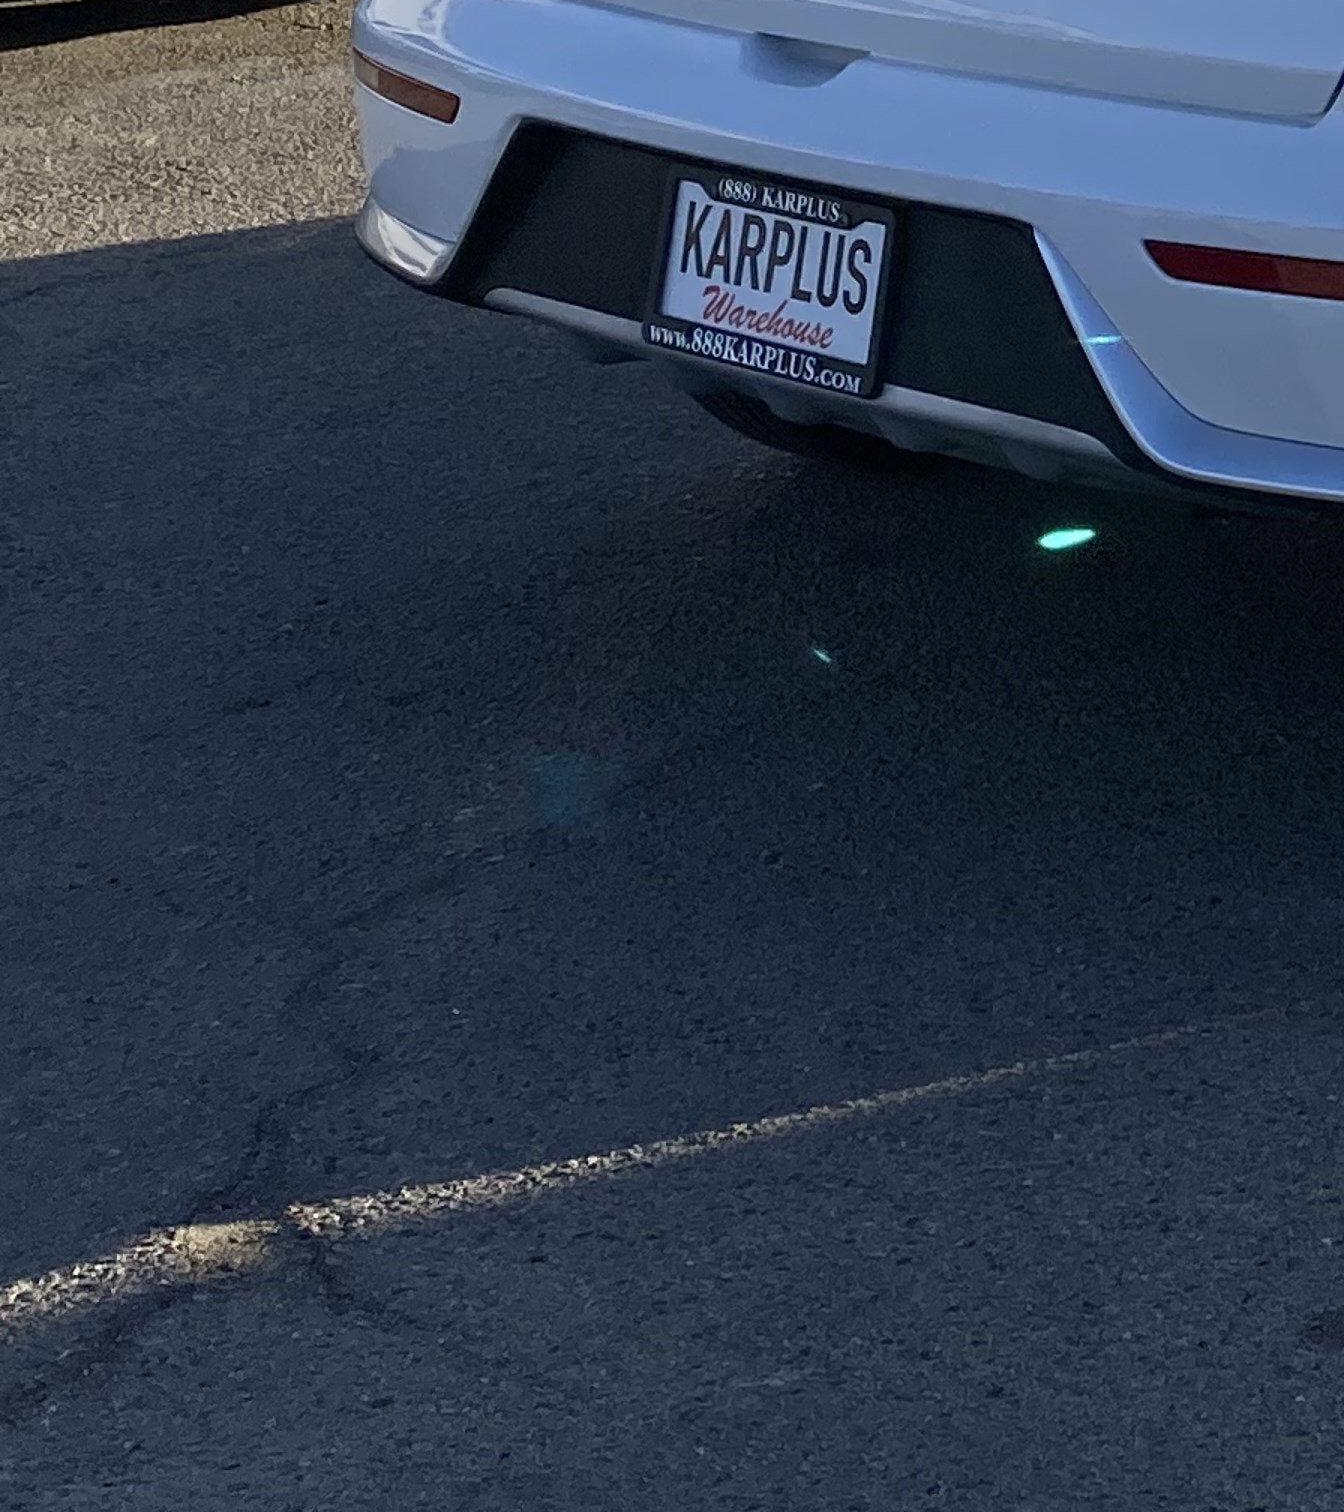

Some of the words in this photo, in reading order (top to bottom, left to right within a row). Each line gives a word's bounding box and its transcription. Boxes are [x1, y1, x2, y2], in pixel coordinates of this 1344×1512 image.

[718, 178, 758, 204] (888)
[761, 186, 842, 224] KARPLUS
[680, 200, 873, 316] KARPLUS
[702, 285, 835, 351] Warehouse
